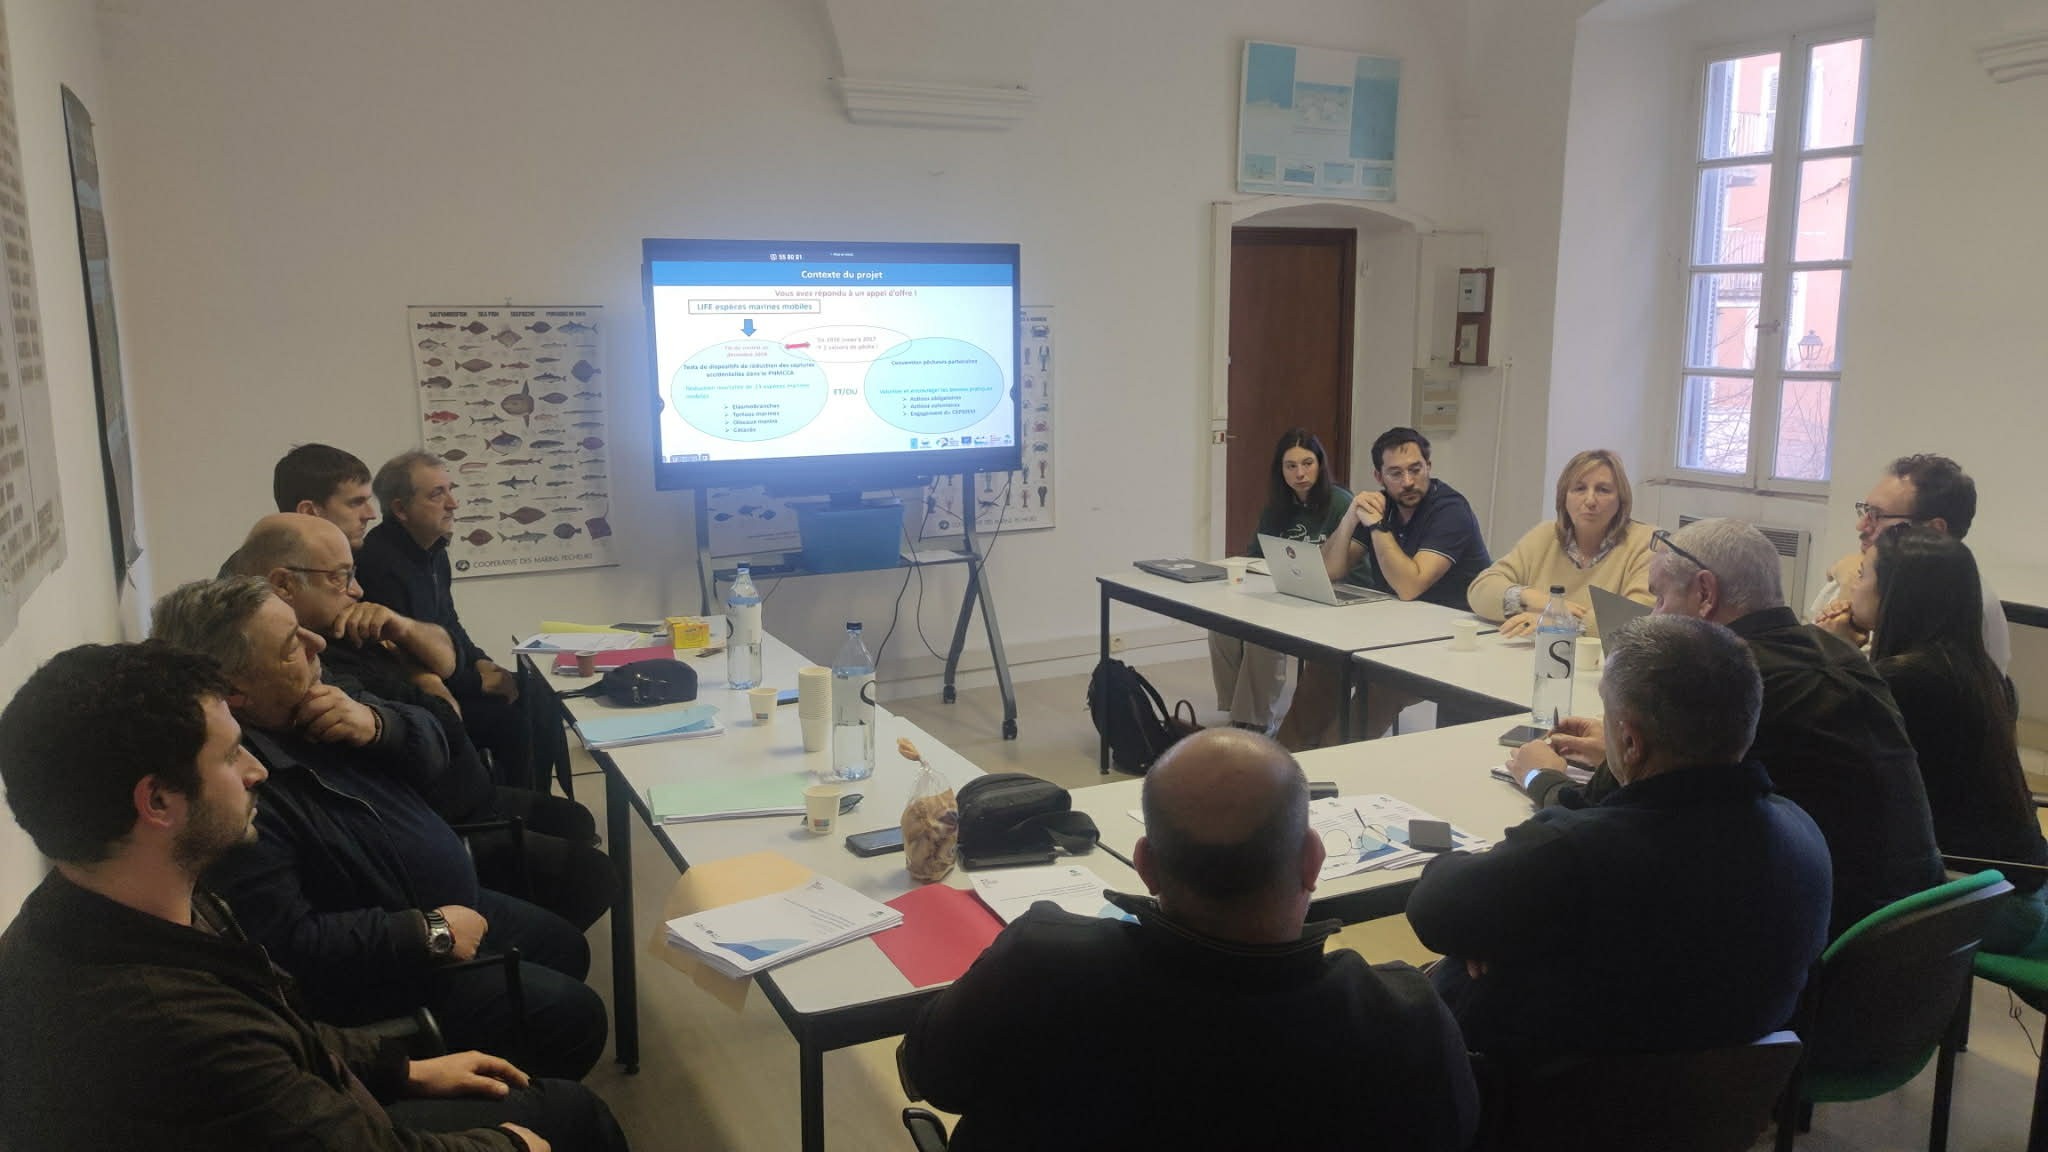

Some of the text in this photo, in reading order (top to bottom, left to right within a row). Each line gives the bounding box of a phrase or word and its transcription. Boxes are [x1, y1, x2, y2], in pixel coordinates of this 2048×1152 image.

[801, 270, 883, 281] Contexte du projet
[815, 289, 847, 298] répondu
[867, 290, 887, 298] appel
[888, 289, 913, 297] d'offre
[697, 303, 713, 311] LIFE
[749, 303, 781, 311] marines
[783, 303, 812, 311] mobiles
[472, 558, 518, 569] COOPERATIVE
[519, 556, 533, 565] DES
[1546, 640, 1572, 679] S
